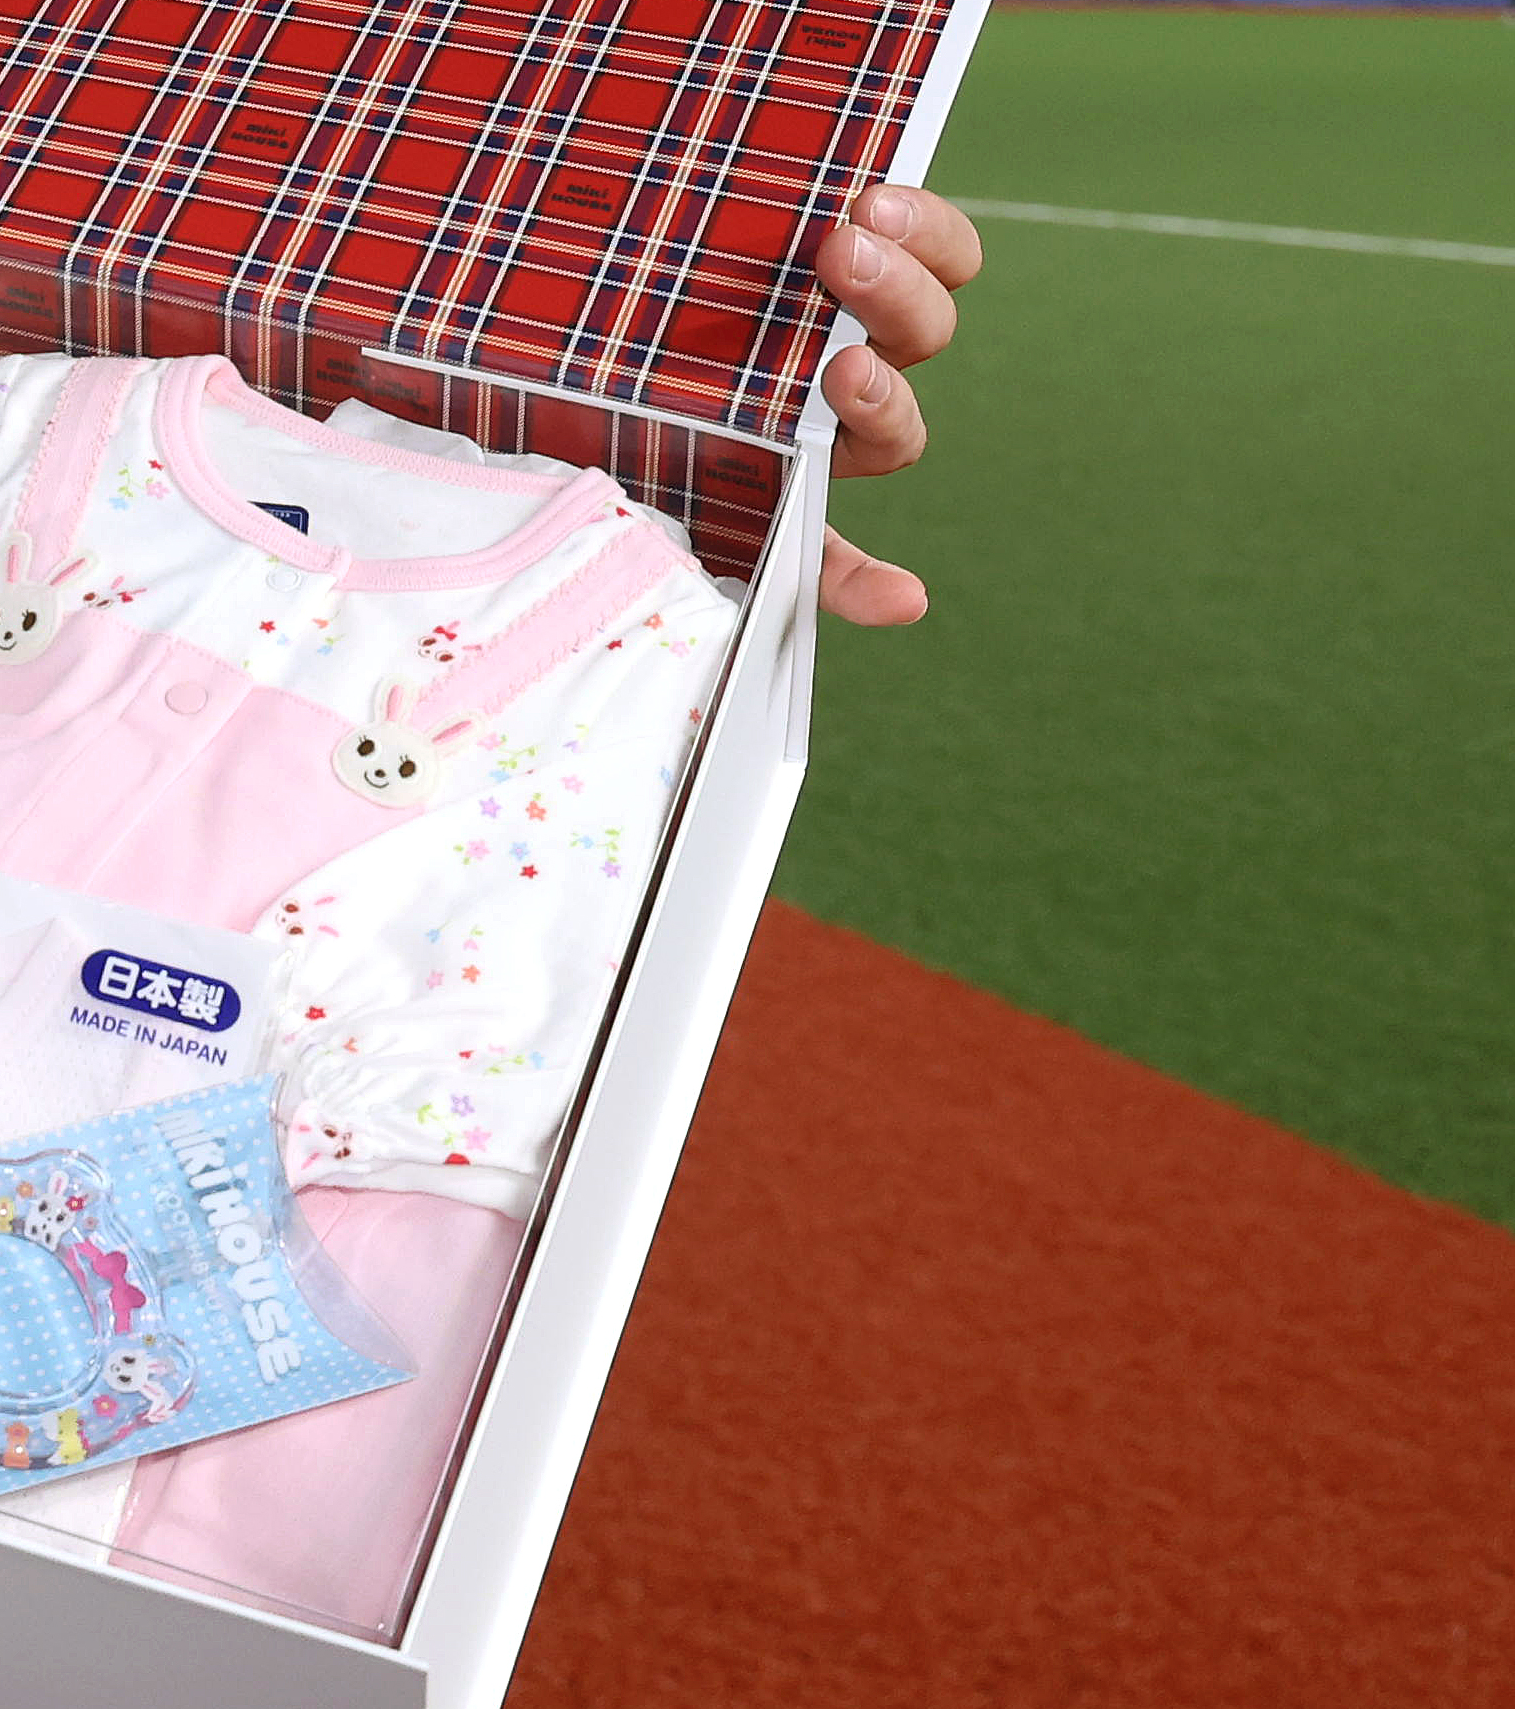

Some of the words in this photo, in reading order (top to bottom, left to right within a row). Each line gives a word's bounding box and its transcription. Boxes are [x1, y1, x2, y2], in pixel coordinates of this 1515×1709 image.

[99, 956, 225, 1026] 日本製
[70, 1006, 131, 1037] MADE
[134, 1024, 156, 1044] IN
[159, 1034, 228, 1067] JAPAN
